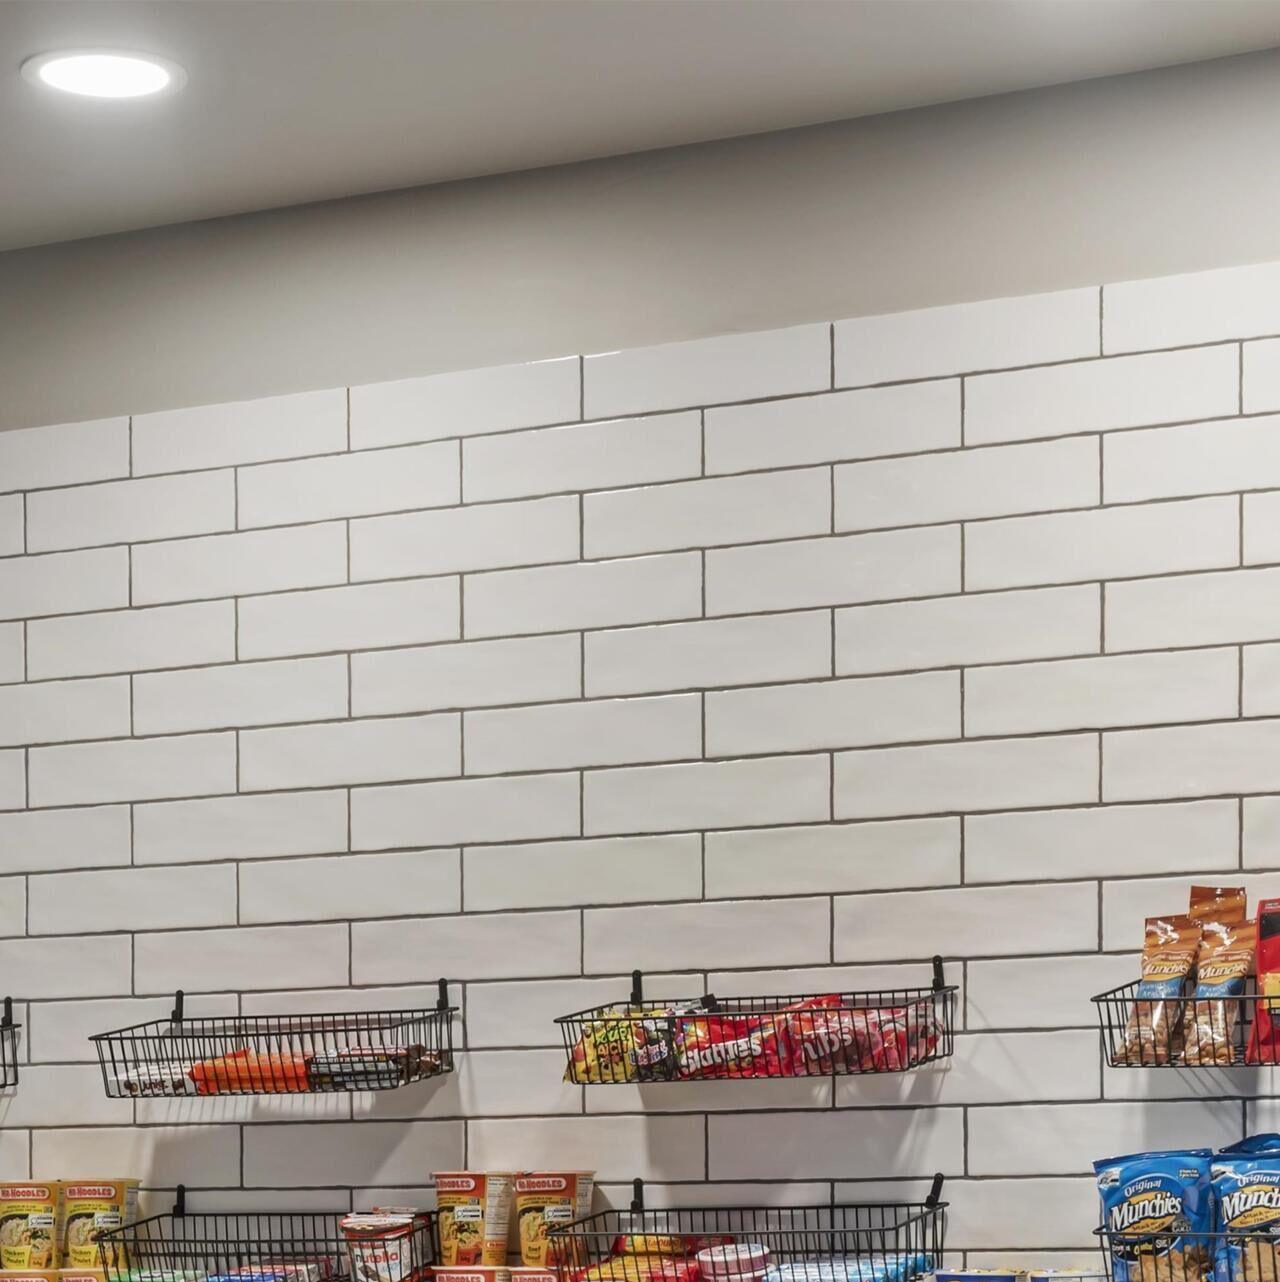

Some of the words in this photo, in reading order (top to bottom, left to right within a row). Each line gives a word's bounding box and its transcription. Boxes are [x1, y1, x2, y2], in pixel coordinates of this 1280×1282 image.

[526, 1180, 563, 1189] NOODLES
[1124, 1179, 1162, 1197] Original
[10, 1189, 46, 1197] NOODLES
[77, 1188, 112, 1196] NOODLES
[1111, 1193, 1183, 1233] Munchies
